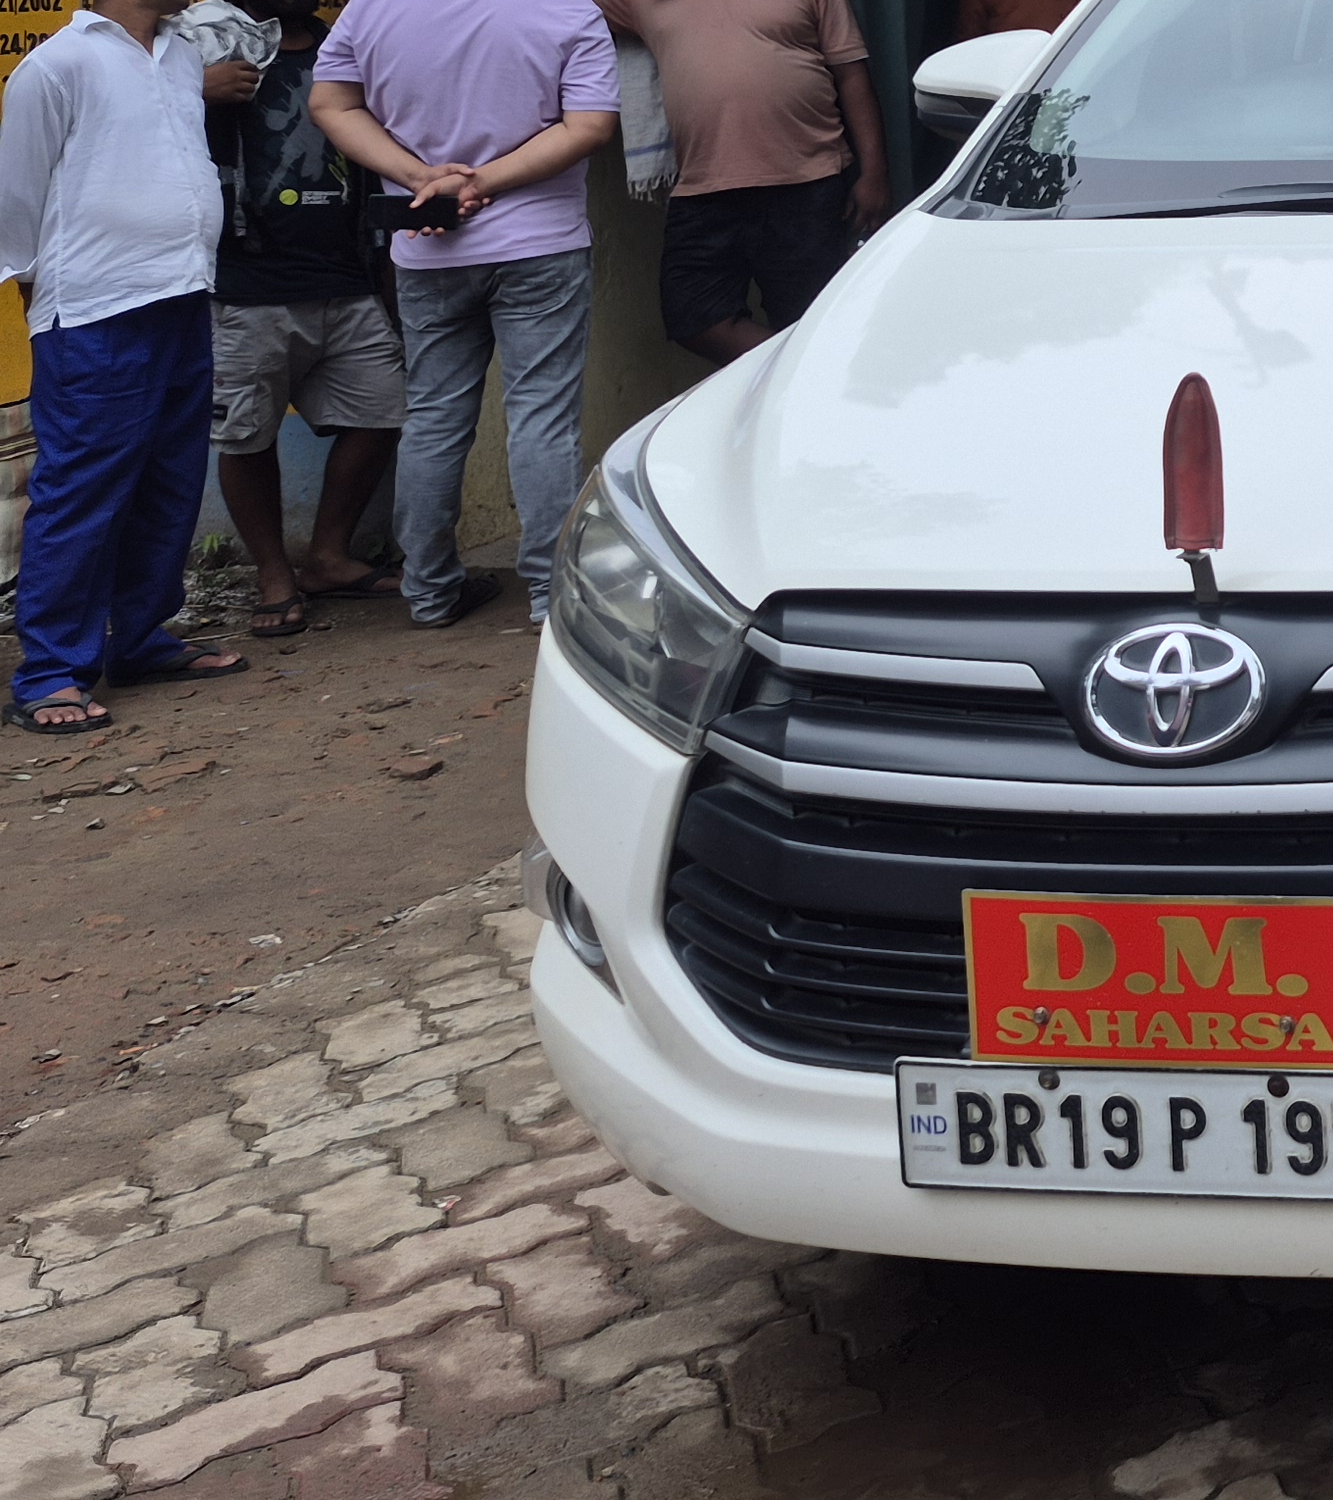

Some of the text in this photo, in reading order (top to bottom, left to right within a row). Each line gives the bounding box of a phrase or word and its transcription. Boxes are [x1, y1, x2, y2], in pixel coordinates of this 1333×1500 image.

[1019, 912, 1309, 998] D.M.
[910, 1114, 947, 1135] IND
[1168, 1095, 1208, 1172] P
